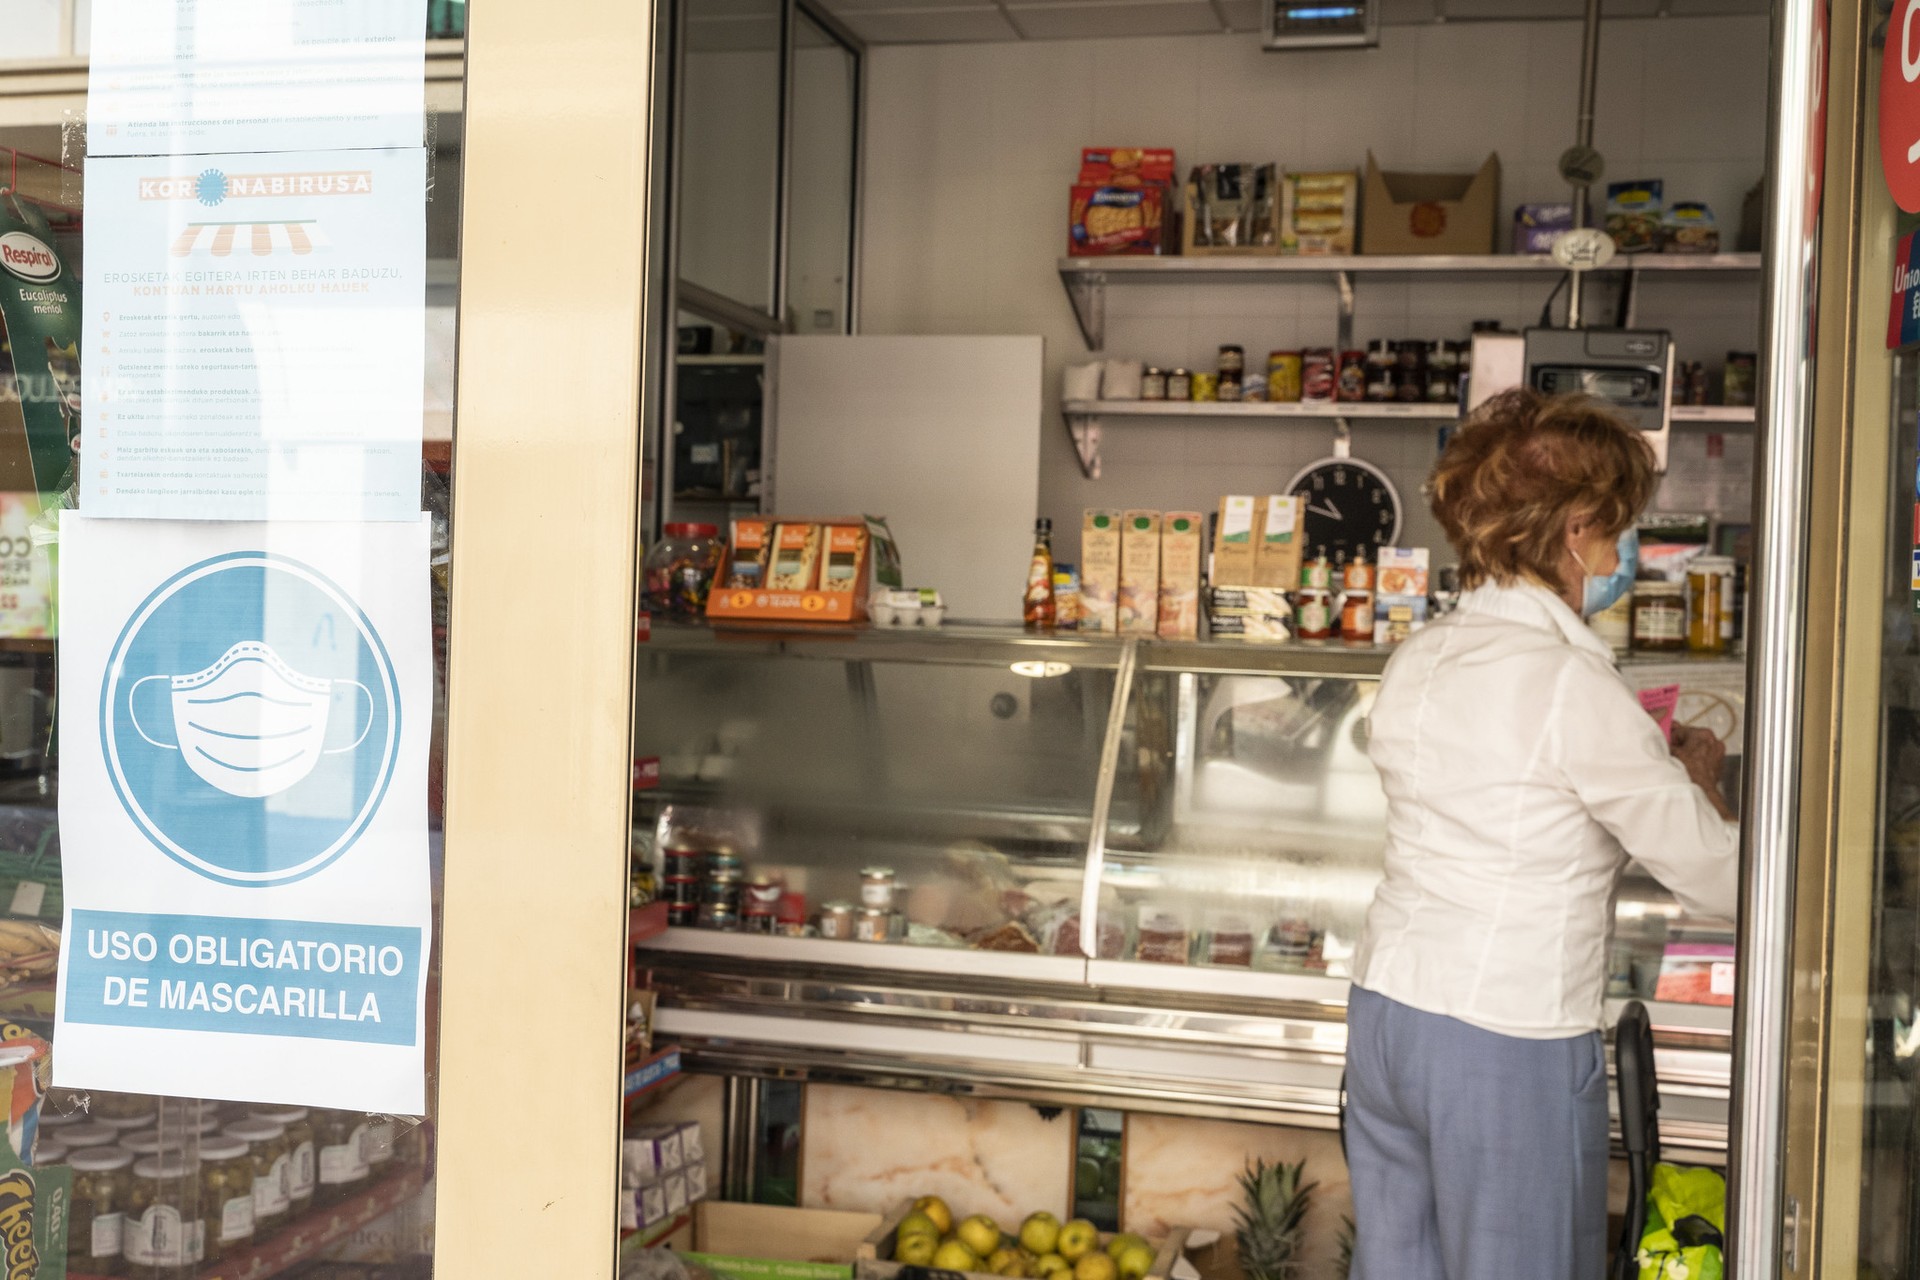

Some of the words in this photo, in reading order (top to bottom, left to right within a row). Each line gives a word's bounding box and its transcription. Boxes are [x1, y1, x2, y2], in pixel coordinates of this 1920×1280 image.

[236, 117, 269, 126] personal
[2, 244, 55, 268] Respiral
[104, 272, 181, 284] EROSKETAK
[185, 270, 242, 282] EGITERA
[247, 270, 286, 281] IRTEN
[292, 268, 337, 280] BEHAR
[19, 288, 68, 303] Eucaliptus
[134, 285, 200, 296] KONTUAN
[206, 284, 254, 296] HARTU
[259, 283, 316, 295] AHOLKU
[321, 282, 370, 294] HAUEK
[33, 304, 62, 314] mentol
[87, 929, 158, 962] USO
[168, 933, 404, 977] OBLIGATORIO
[102, 976, 150, 1008] DE
[160, 979, 382, 1023] MASCARILLA
